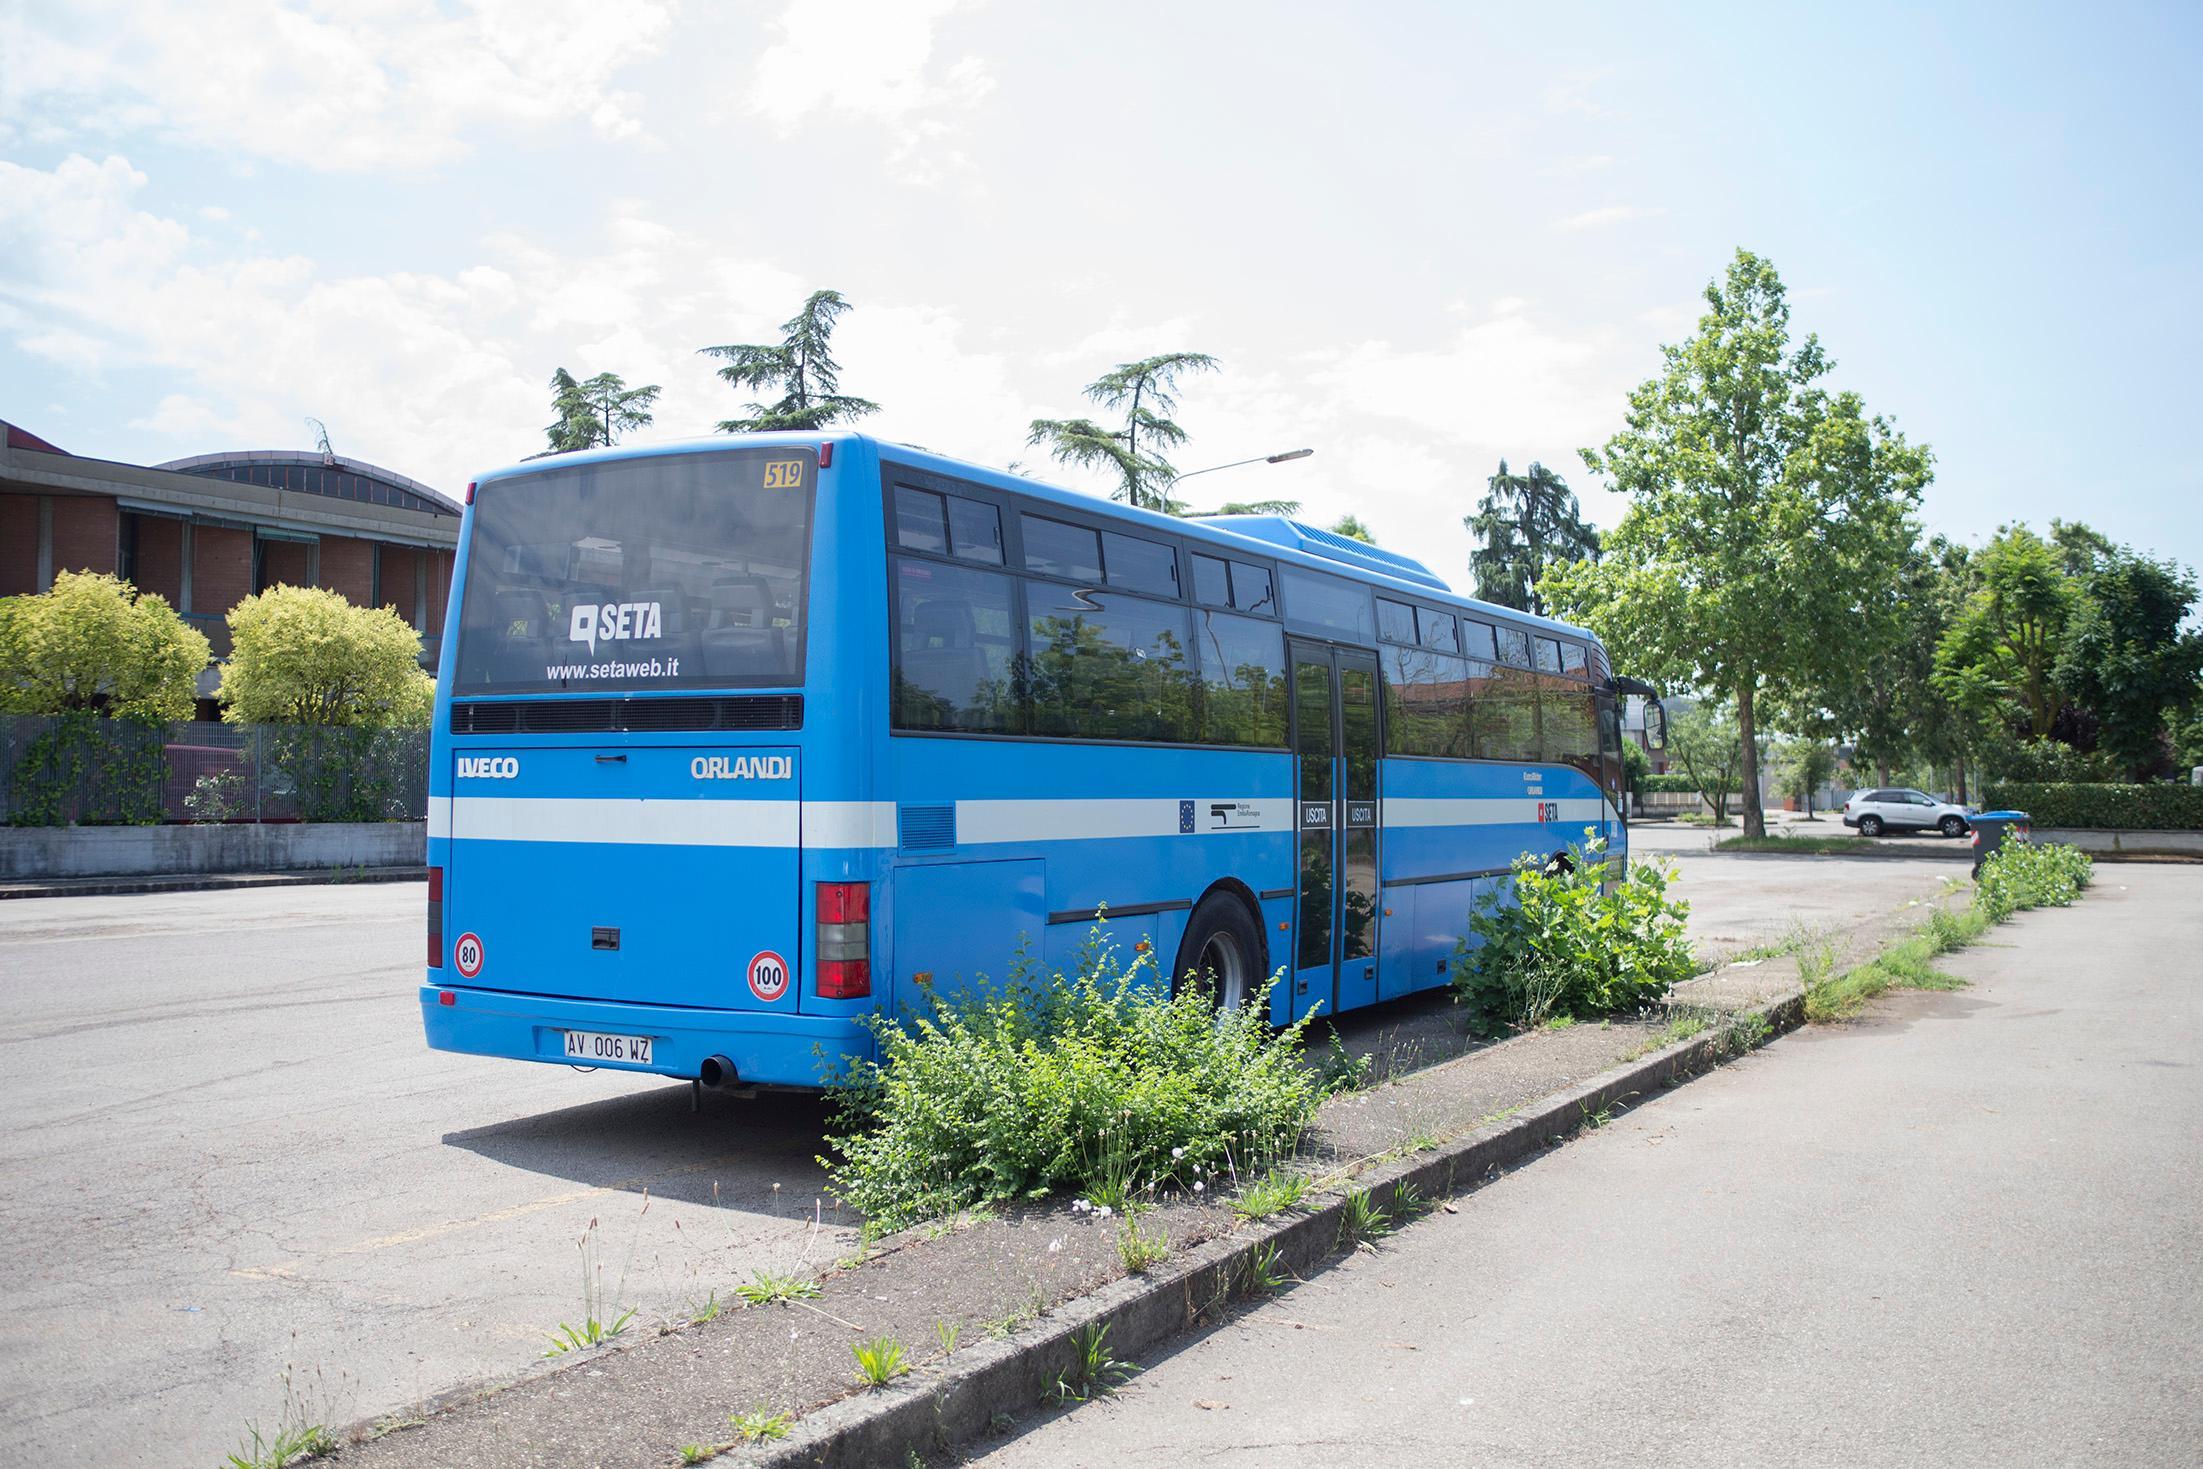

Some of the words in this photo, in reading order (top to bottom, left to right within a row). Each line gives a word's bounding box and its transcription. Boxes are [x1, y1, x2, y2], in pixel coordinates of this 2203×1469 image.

[767, 463, 800, 486] 519
[599, 602, 662, 640] SETA
[546, 658, 679, 680] www.setaweb.it
[457, 757, 519, 778] IVECO
[691, 756, 792, 779] ORLANDI
[1305, 807, 1327, 823] USCITA
[1351, 807, 1372, 822] USCITA
[1544, 802, 1559, 822] SETA
[462, 946, 476, 964] 80
[756, 965, 782, 986] 100
[567, 1032, 585, 1054] AV
[594, 1036, 624, 1059] 006
[629, 1038, 649, 1061] WZ
